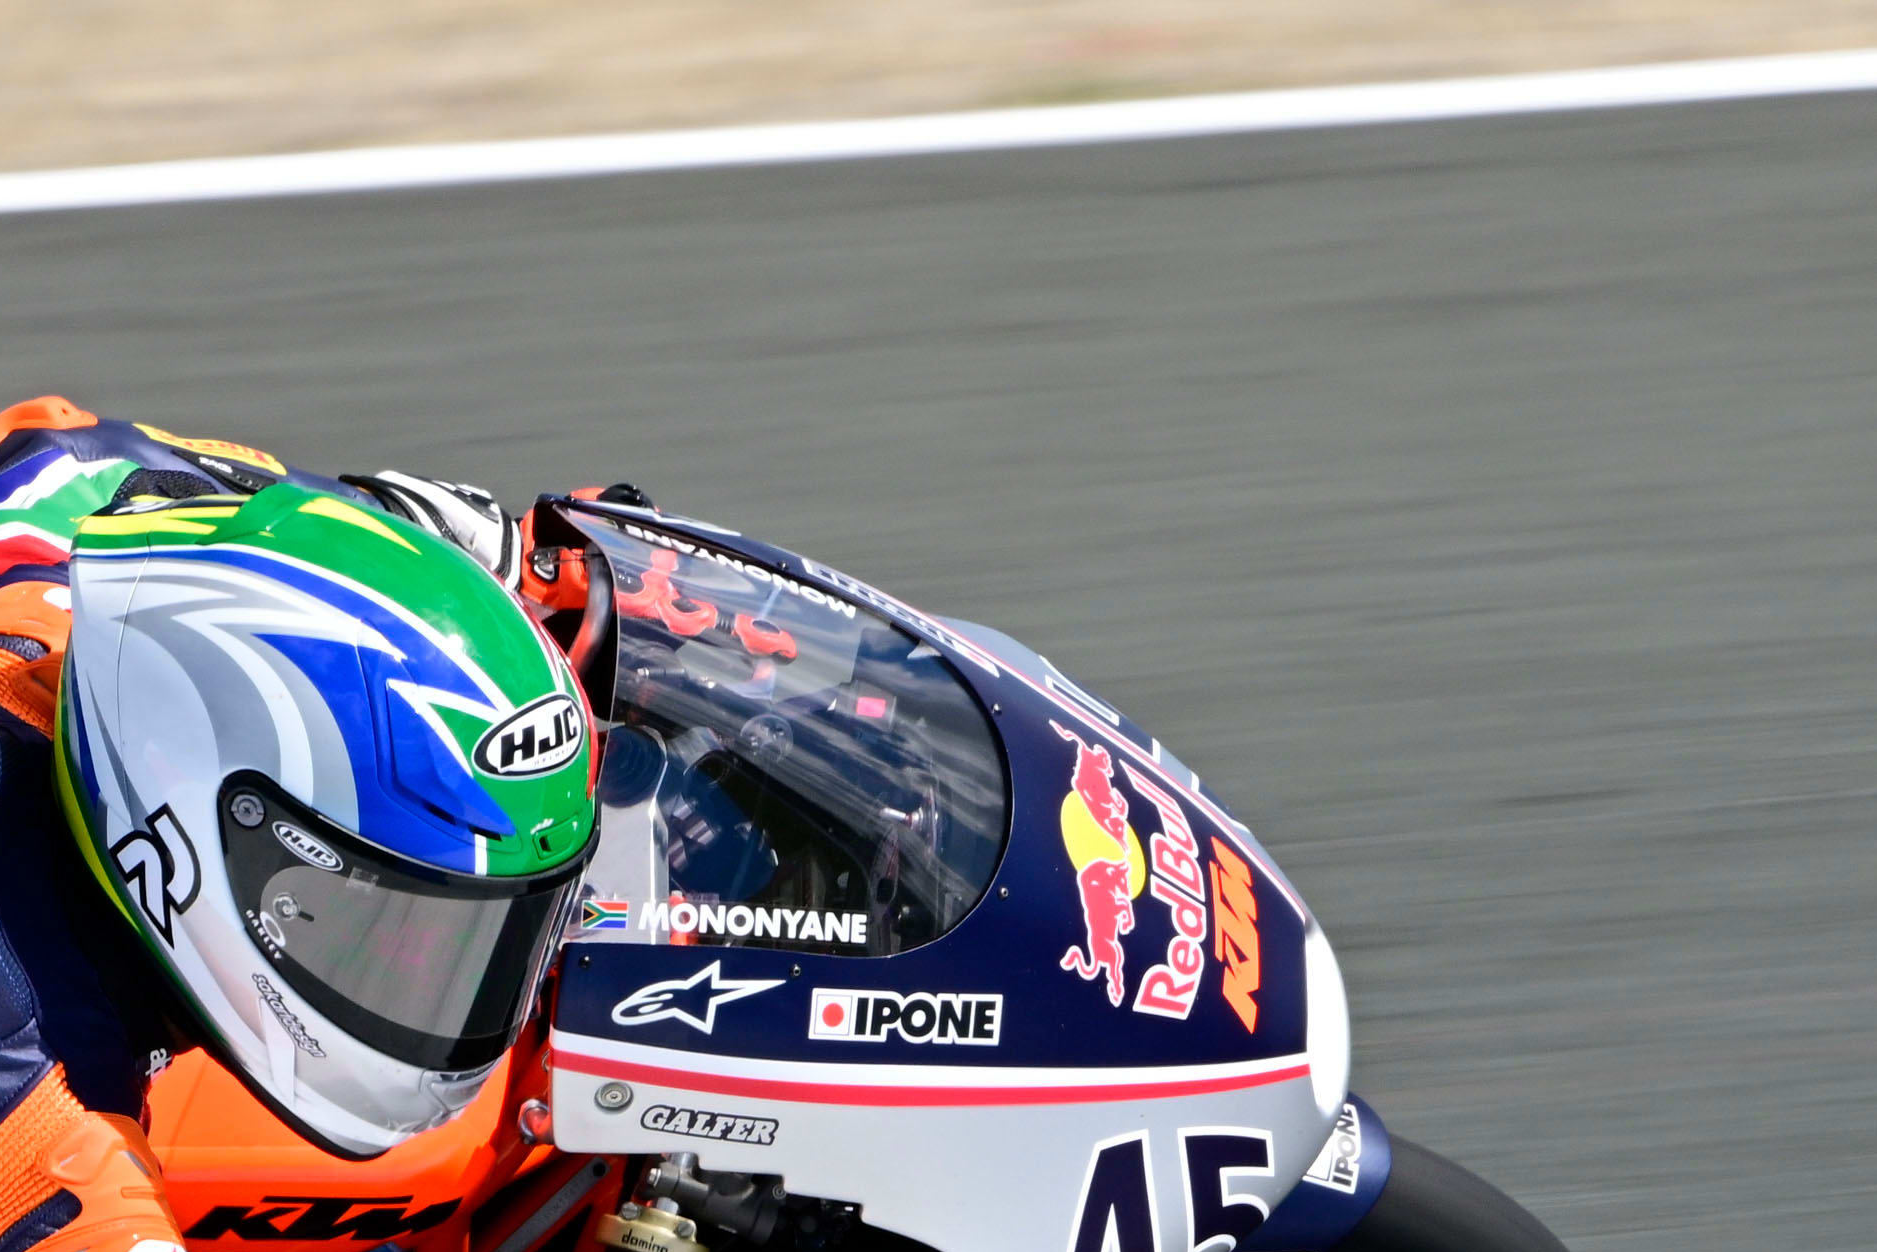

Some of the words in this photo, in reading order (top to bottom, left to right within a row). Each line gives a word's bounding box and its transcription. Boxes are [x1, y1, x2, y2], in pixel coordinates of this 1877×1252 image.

[499, 704, 578, 769] HJC
[280, 828, 336, 866] HJC
[1119, 759, 1205, 901] Bull
[245, 909, 283, 960] OAKLEY
[637, 902, 868, 944] MONONYANE
[1133, 874, 1206, 1020] Red
[1209, 836, 1260, 1034] KTM
[853, 995, 997, 1041] IPONE
[640, 1104, 780, 1146] GALFER
[182, 1195, 464, 1241] KTM
